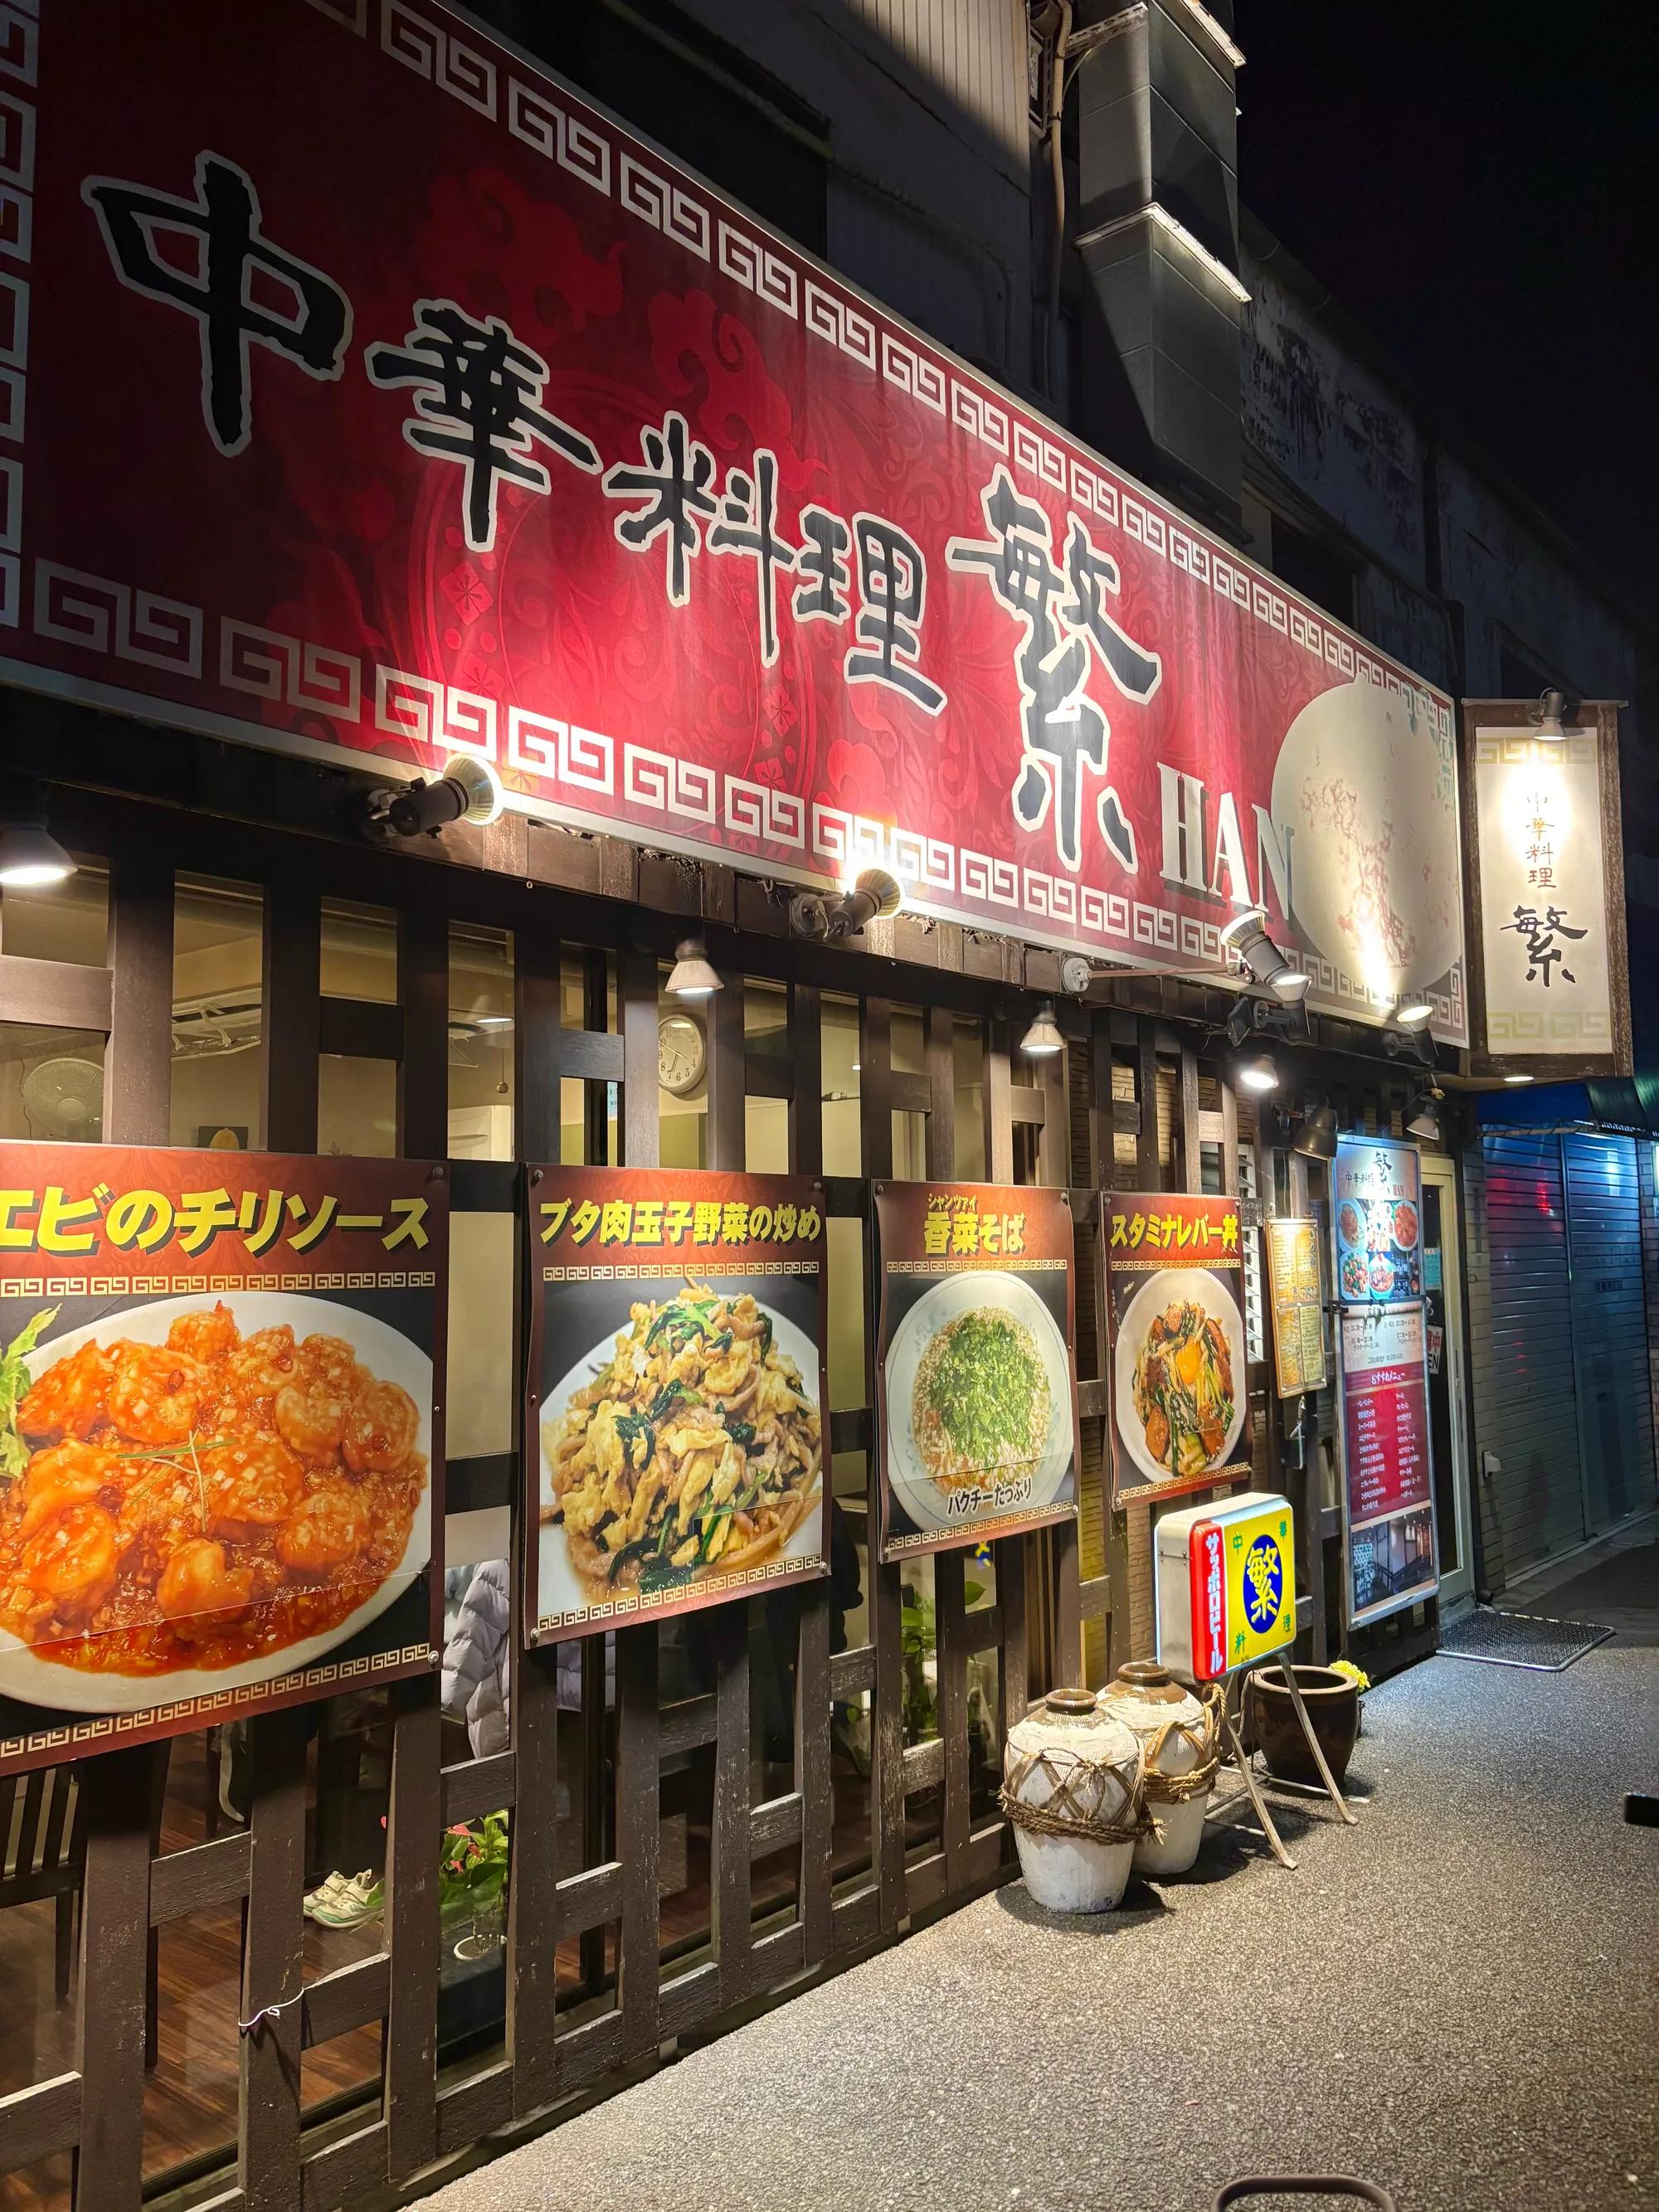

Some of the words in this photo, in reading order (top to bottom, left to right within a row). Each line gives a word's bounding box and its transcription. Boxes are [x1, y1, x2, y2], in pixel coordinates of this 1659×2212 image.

[80, 149, 947, 717] 中華料理
[946, 463, 1161, 874] 繁
[1156, 761, 1292, 921] HAN
[1525, 790, 1557, 888] 中華料理
[1500, 905, 1588, 987] 繁
[0, 1183, 430, 1254] エビのチリソース
[541, 1198, 820, 1244] ブタ肉玉子野菜の炒め
[924, 1211, 1026, 1254] 香菜そば
[1110, 1213, 1238, 1248] スタミナレバー丼
[947, 1476, 1033, 1515] パクチーたっぷり
[1233, 1531, 1243, 1554] 中
[1206, 1533, 1224, 1674] サッポロビール
[1247, 1544, 1280, 1623] 繁
[1235, 1631, 1246, 1654] 料
